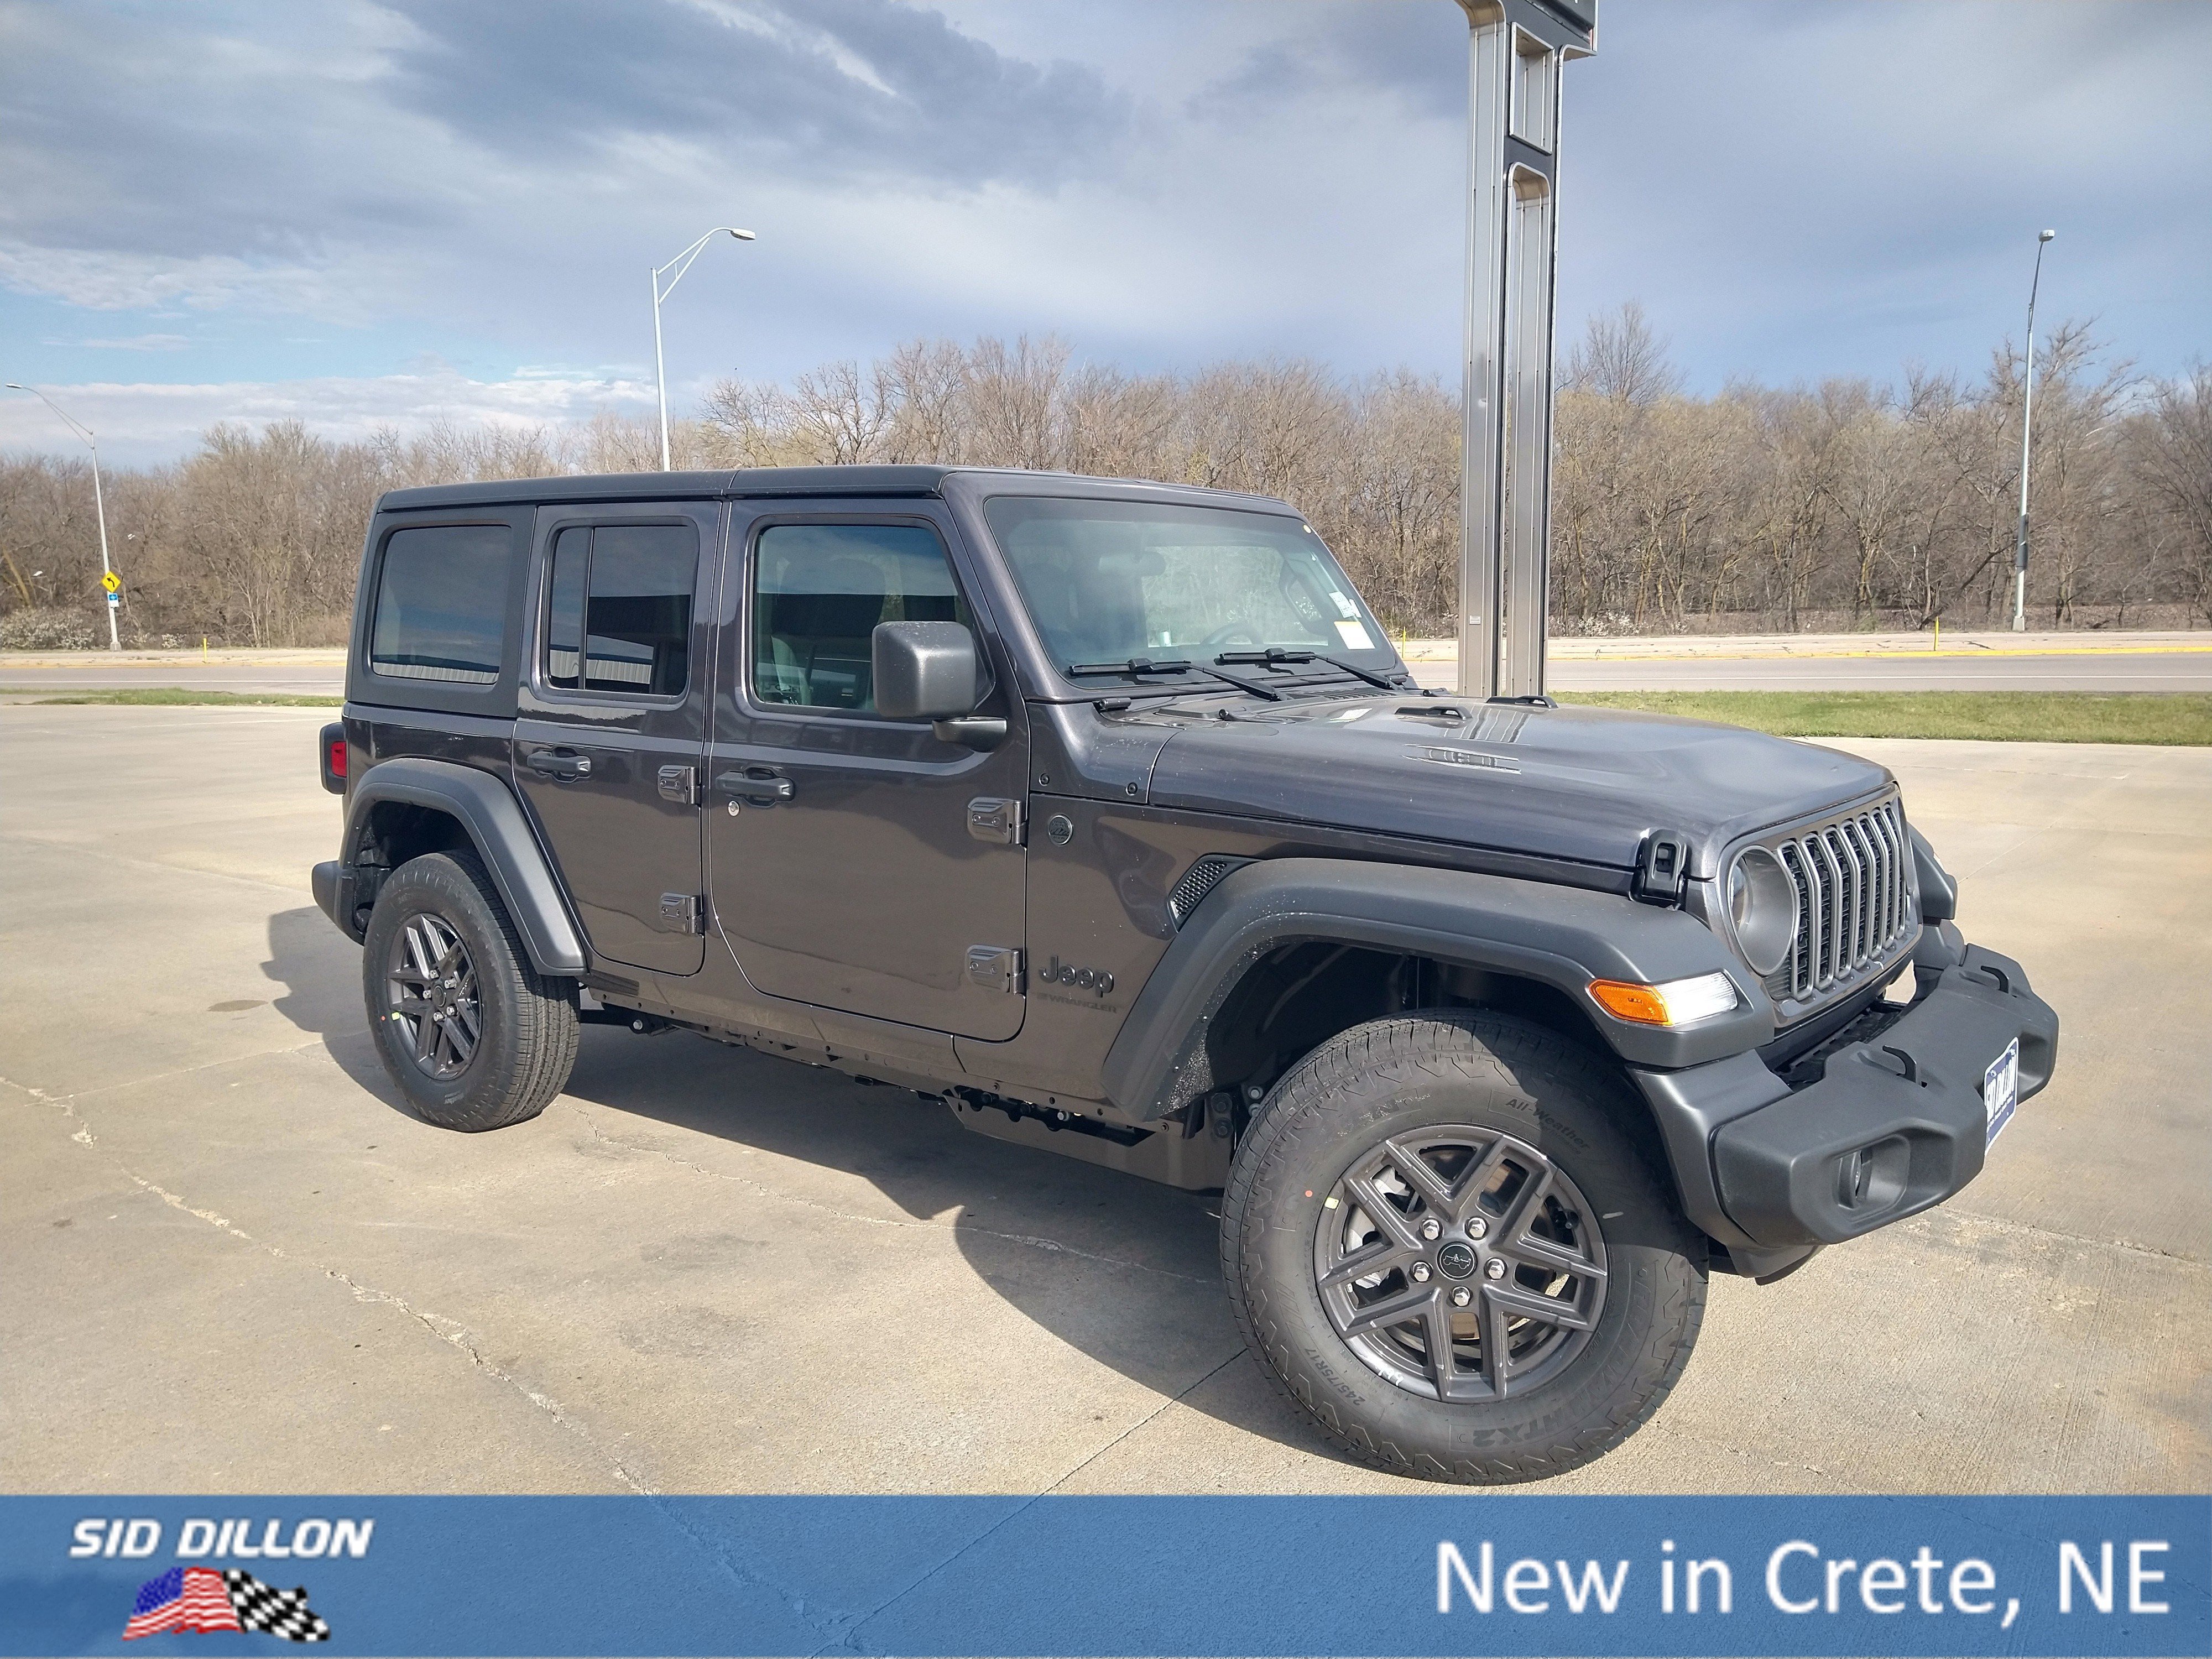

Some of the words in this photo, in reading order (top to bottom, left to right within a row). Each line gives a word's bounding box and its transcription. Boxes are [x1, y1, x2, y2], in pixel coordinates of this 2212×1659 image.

[1038, 955, 1114, 998] Jeep
[1050, 995, 1117, 1014] WRANGLER
[1505, 1098, 1590, 1149] All-Weather
[1303, 1345, 1366, 1408] 245/75R17
